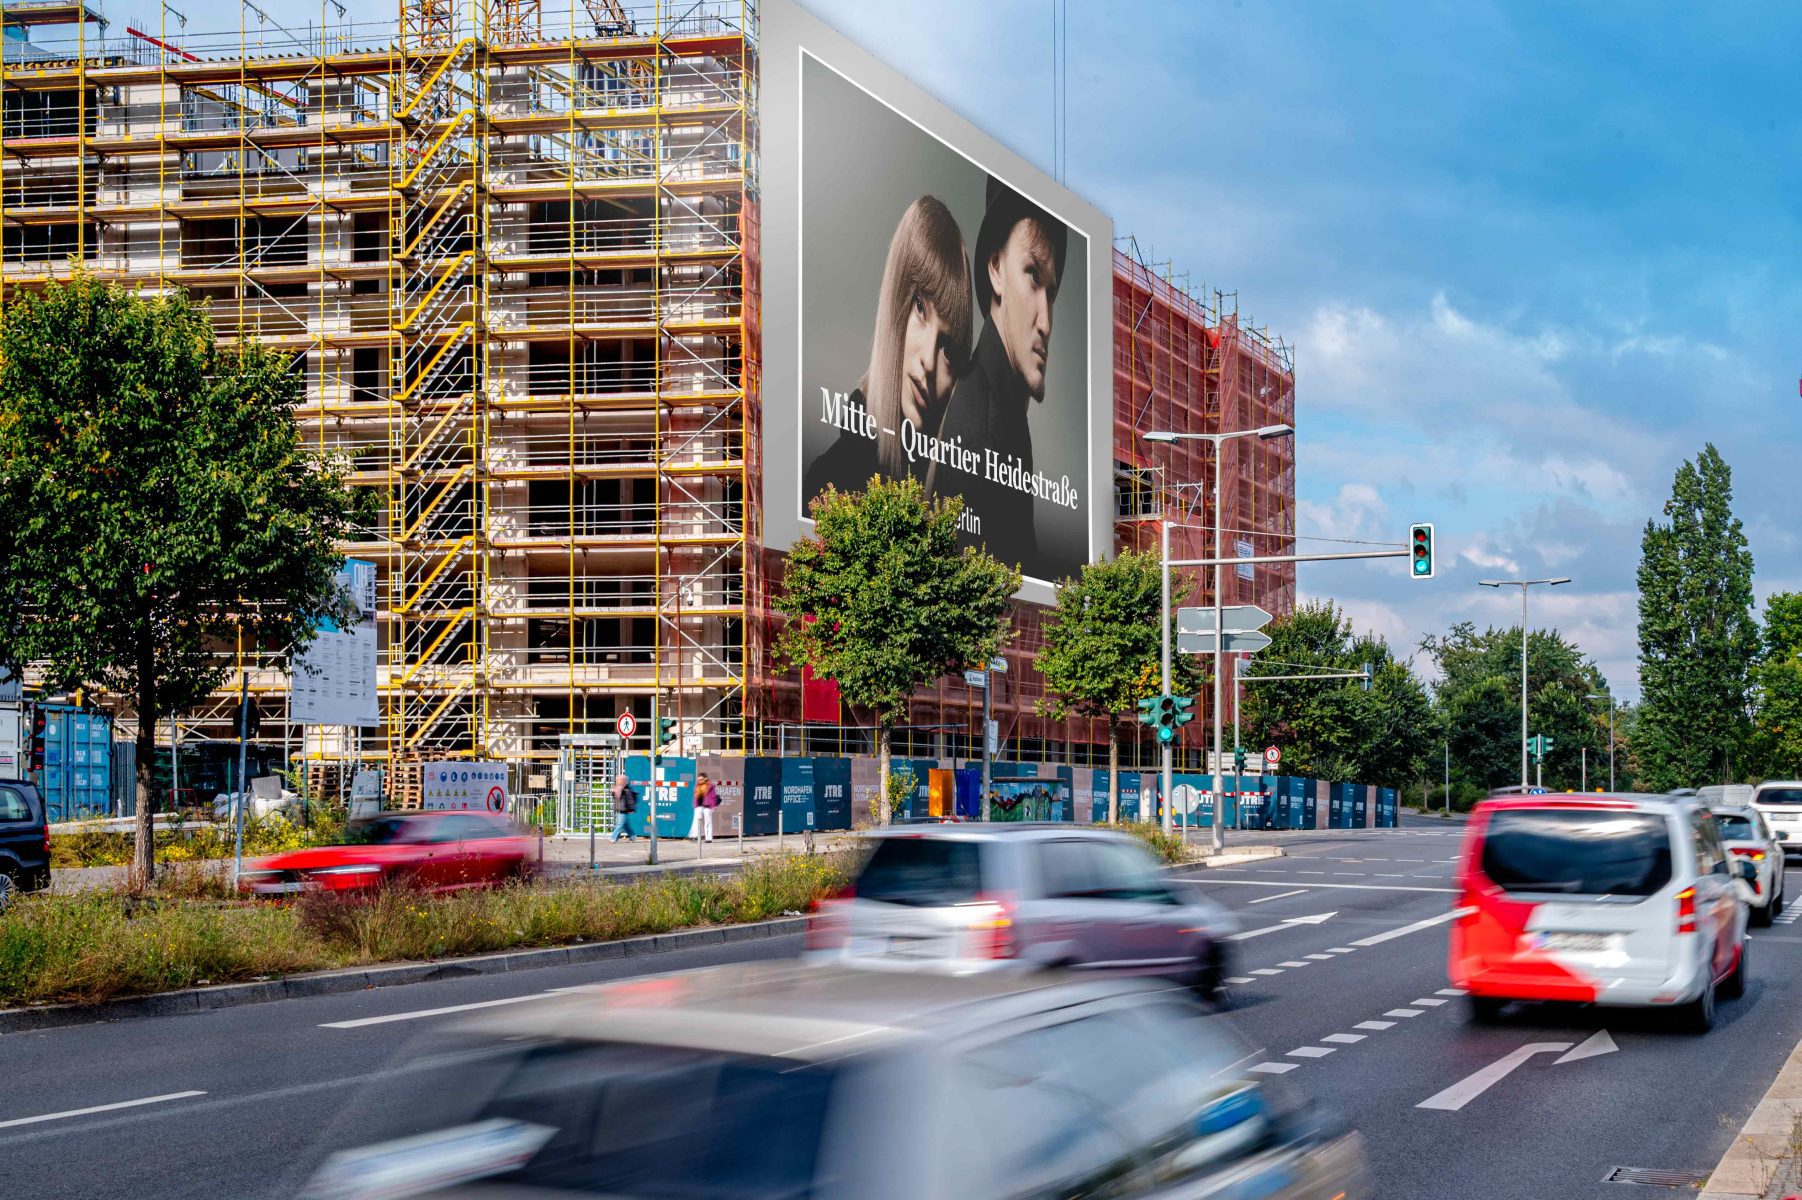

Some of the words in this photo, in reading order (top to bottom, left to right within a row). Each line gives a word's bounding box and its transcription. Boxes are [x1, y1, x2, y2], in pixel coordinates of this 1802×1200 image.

[820, 386, 877, 440] Mitte
[901, 418, 981, 475] Quartier
[984, 447, 1078, 510] Heidestraße
[956, 506, 981, 536] erlin
[753, 785, 773, 800] JTRE
[783, 785, 813, 795] NORDHAFEN
[824, 784, 843, 798] JTRE
[1239, 795, 1265, 805] JTRE
